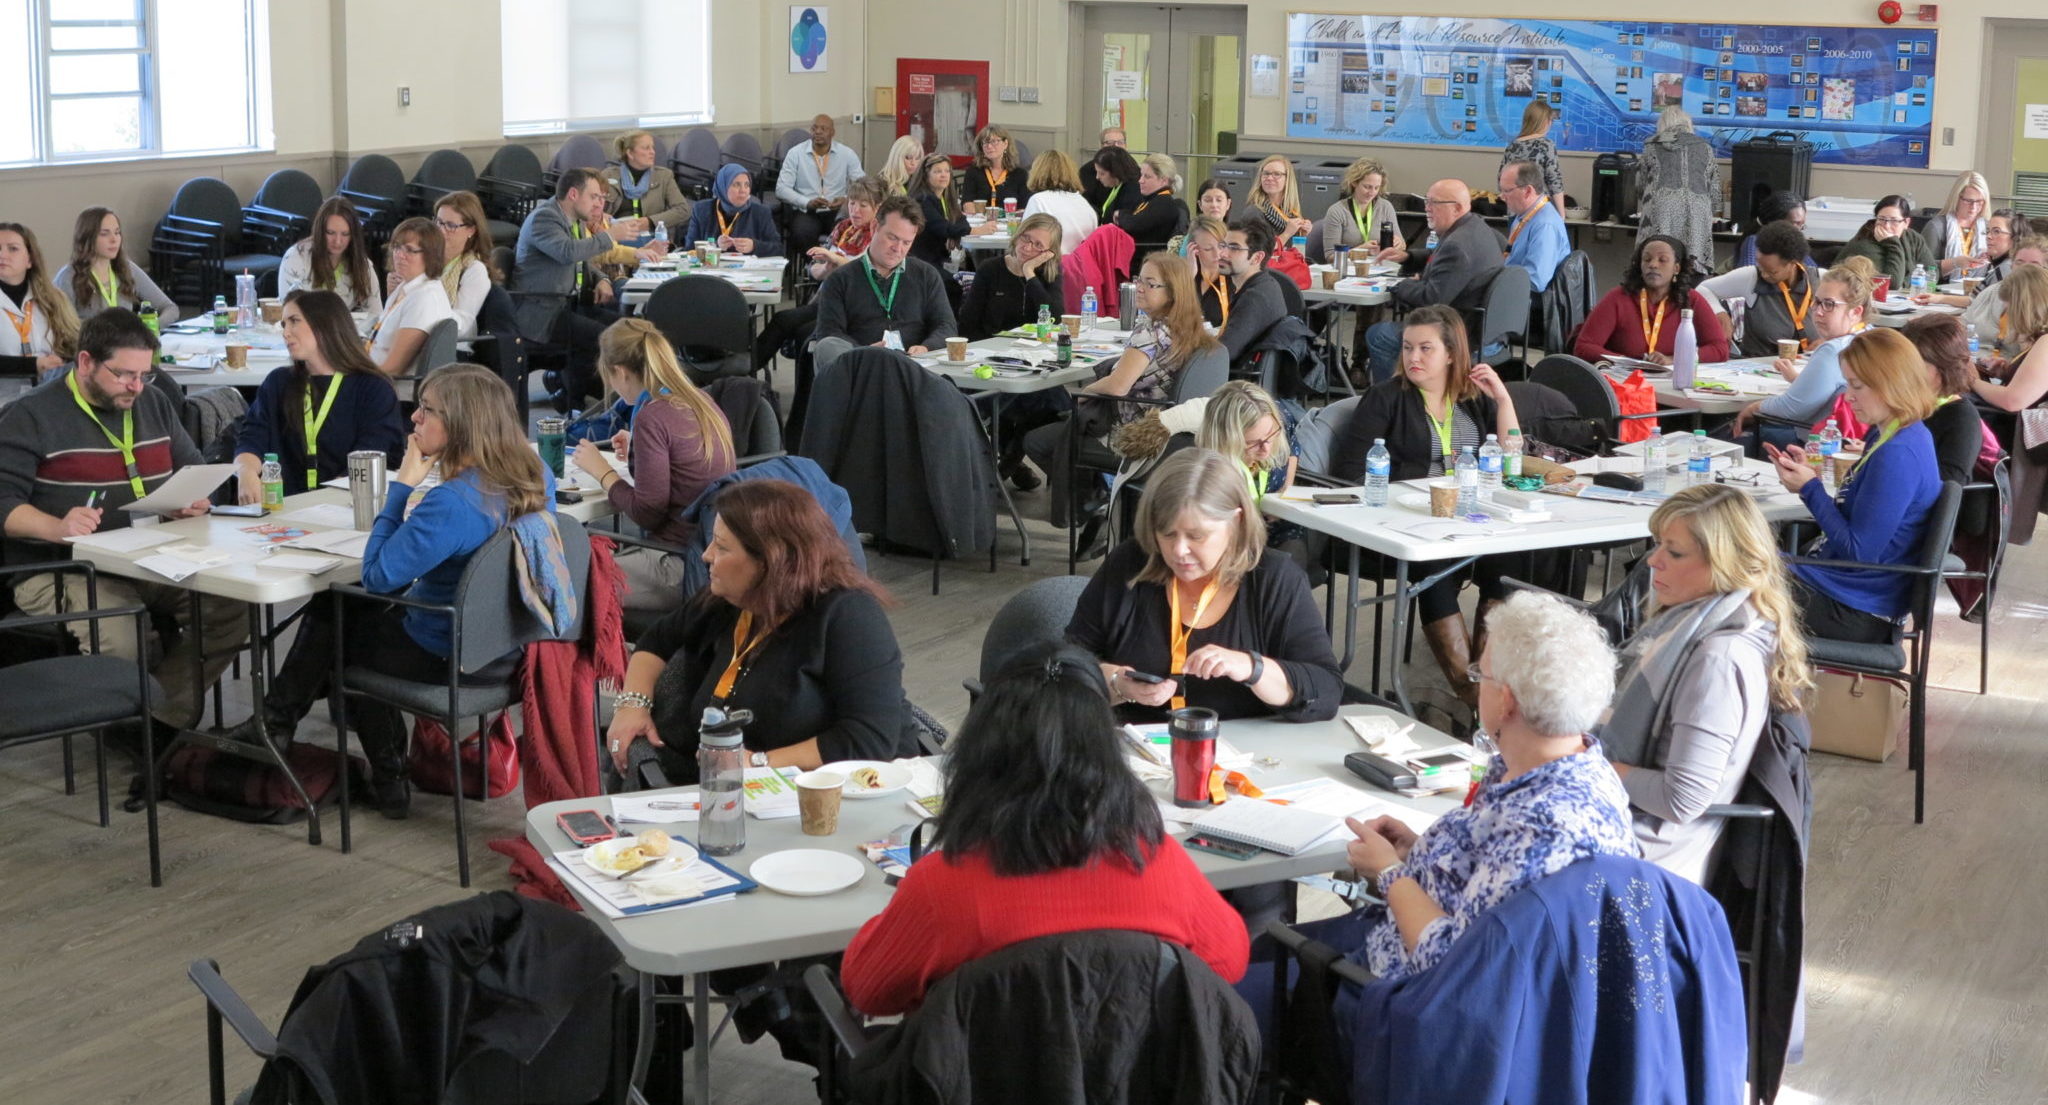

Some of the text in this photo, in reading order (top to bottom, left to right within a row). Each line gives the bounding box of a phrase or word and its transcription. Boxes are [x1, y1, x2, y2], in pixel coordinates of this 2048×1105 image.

[1305, 18, 1354, 41] Child
[1440, 21, 1501, 43] Resource
[1499, 23, 1568, 46] Institute
[1737, 43, 1784, 54] 2000-2005
[1823, 49, 1872, 59] 2006-2010
